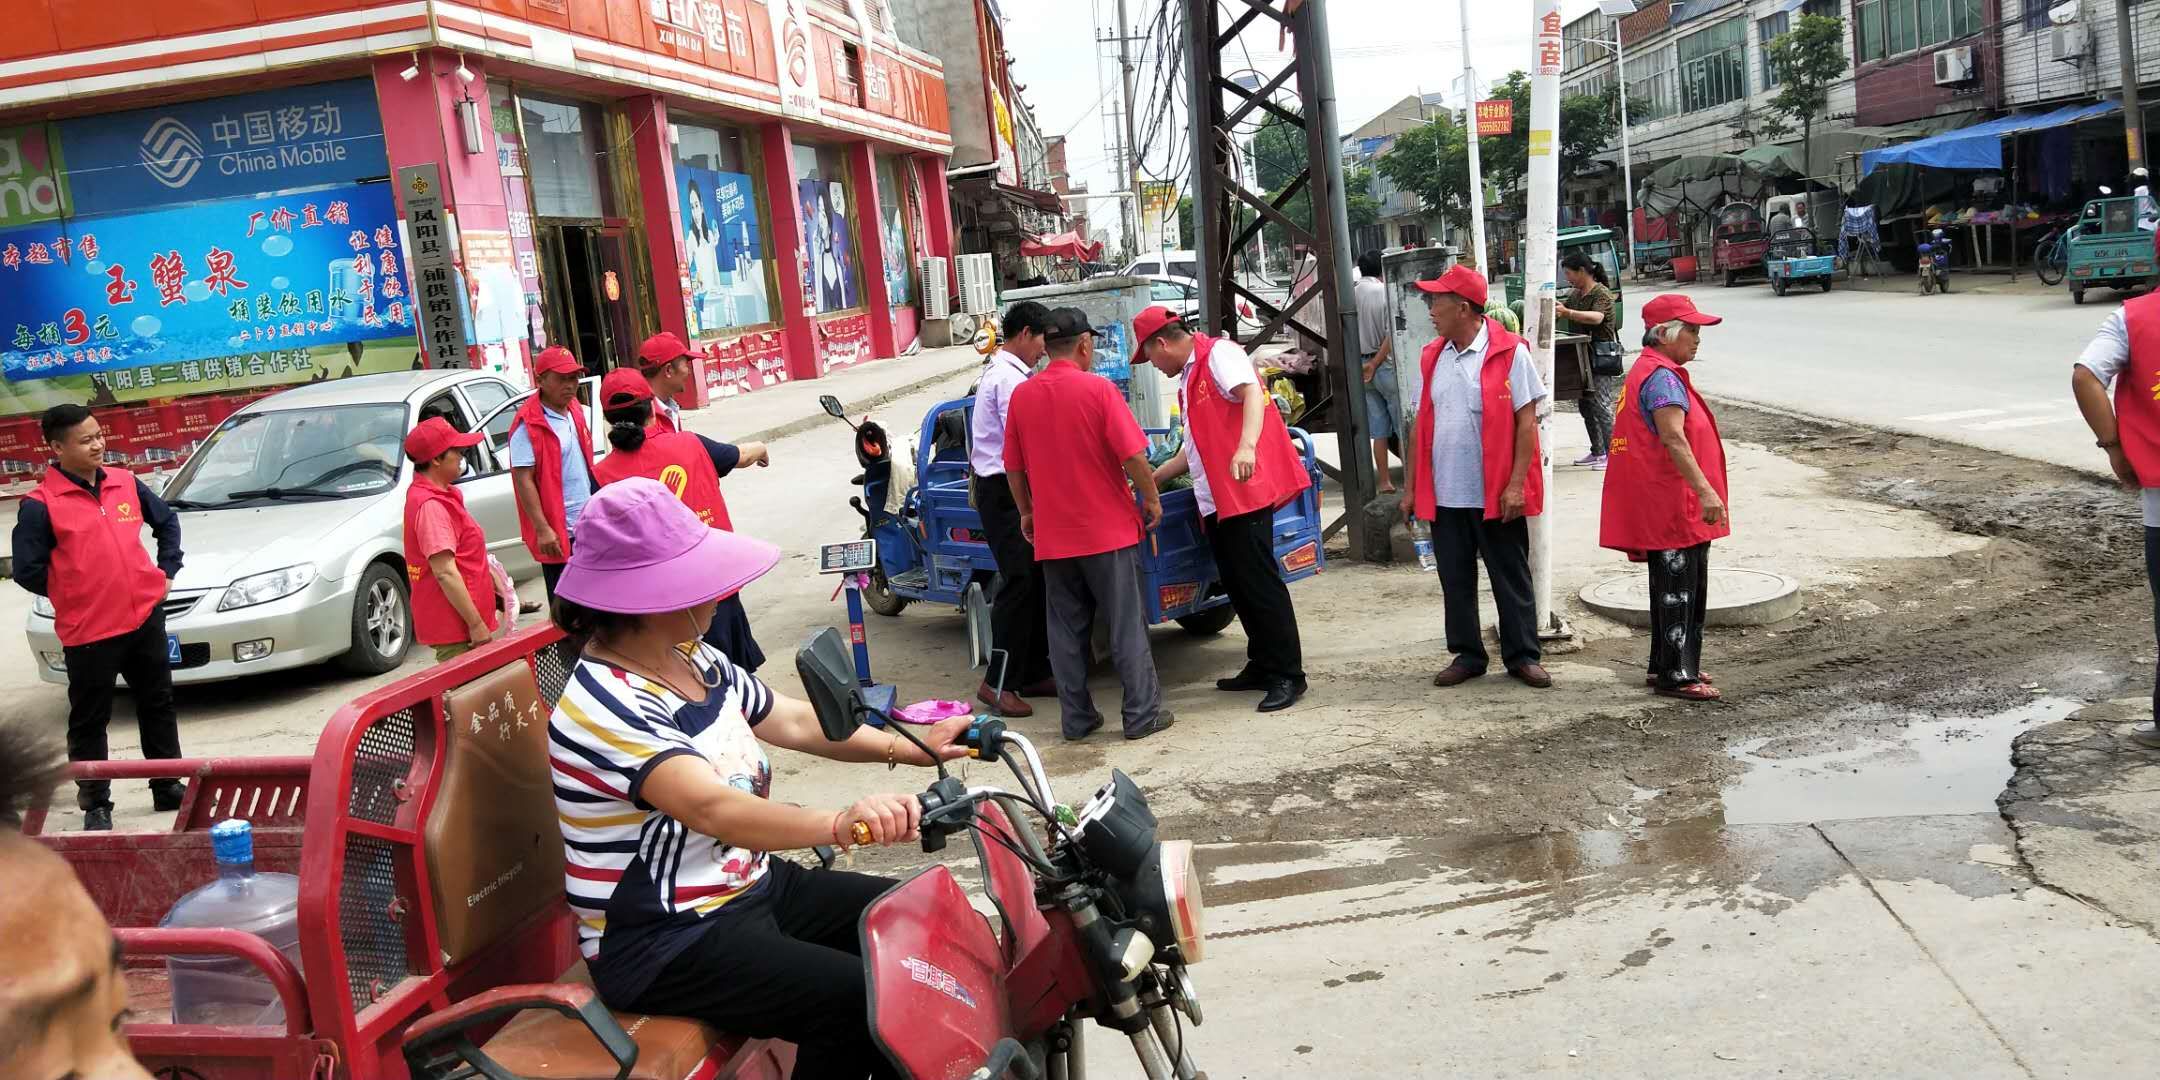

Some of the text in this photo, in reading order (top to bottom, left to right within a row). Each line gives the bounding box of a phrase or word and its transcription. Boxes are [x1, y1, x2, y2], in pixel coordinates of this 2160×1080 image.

[212, 101, 342, 149] 中国移动
[219, 142, 346, 175] China Mobile
[247, 200, 350, 237] 厂价直销
[105, 245, 248, 307] 玉蟹泉
[349, 229, 383, 328] 让利于民
[374, 223, 405, 325] 健康饮用
[228, 288, 353, 322] 桶装饮用水
[12, 307, 119, 350] 每桶3元
[90, 347, 314, 391] 凤阳县二铺供销合作社
[470, 690, 516, 735] 金品质
[499, 699, 538, 742] 行天下
[466, 879, 498, 908] Electric
